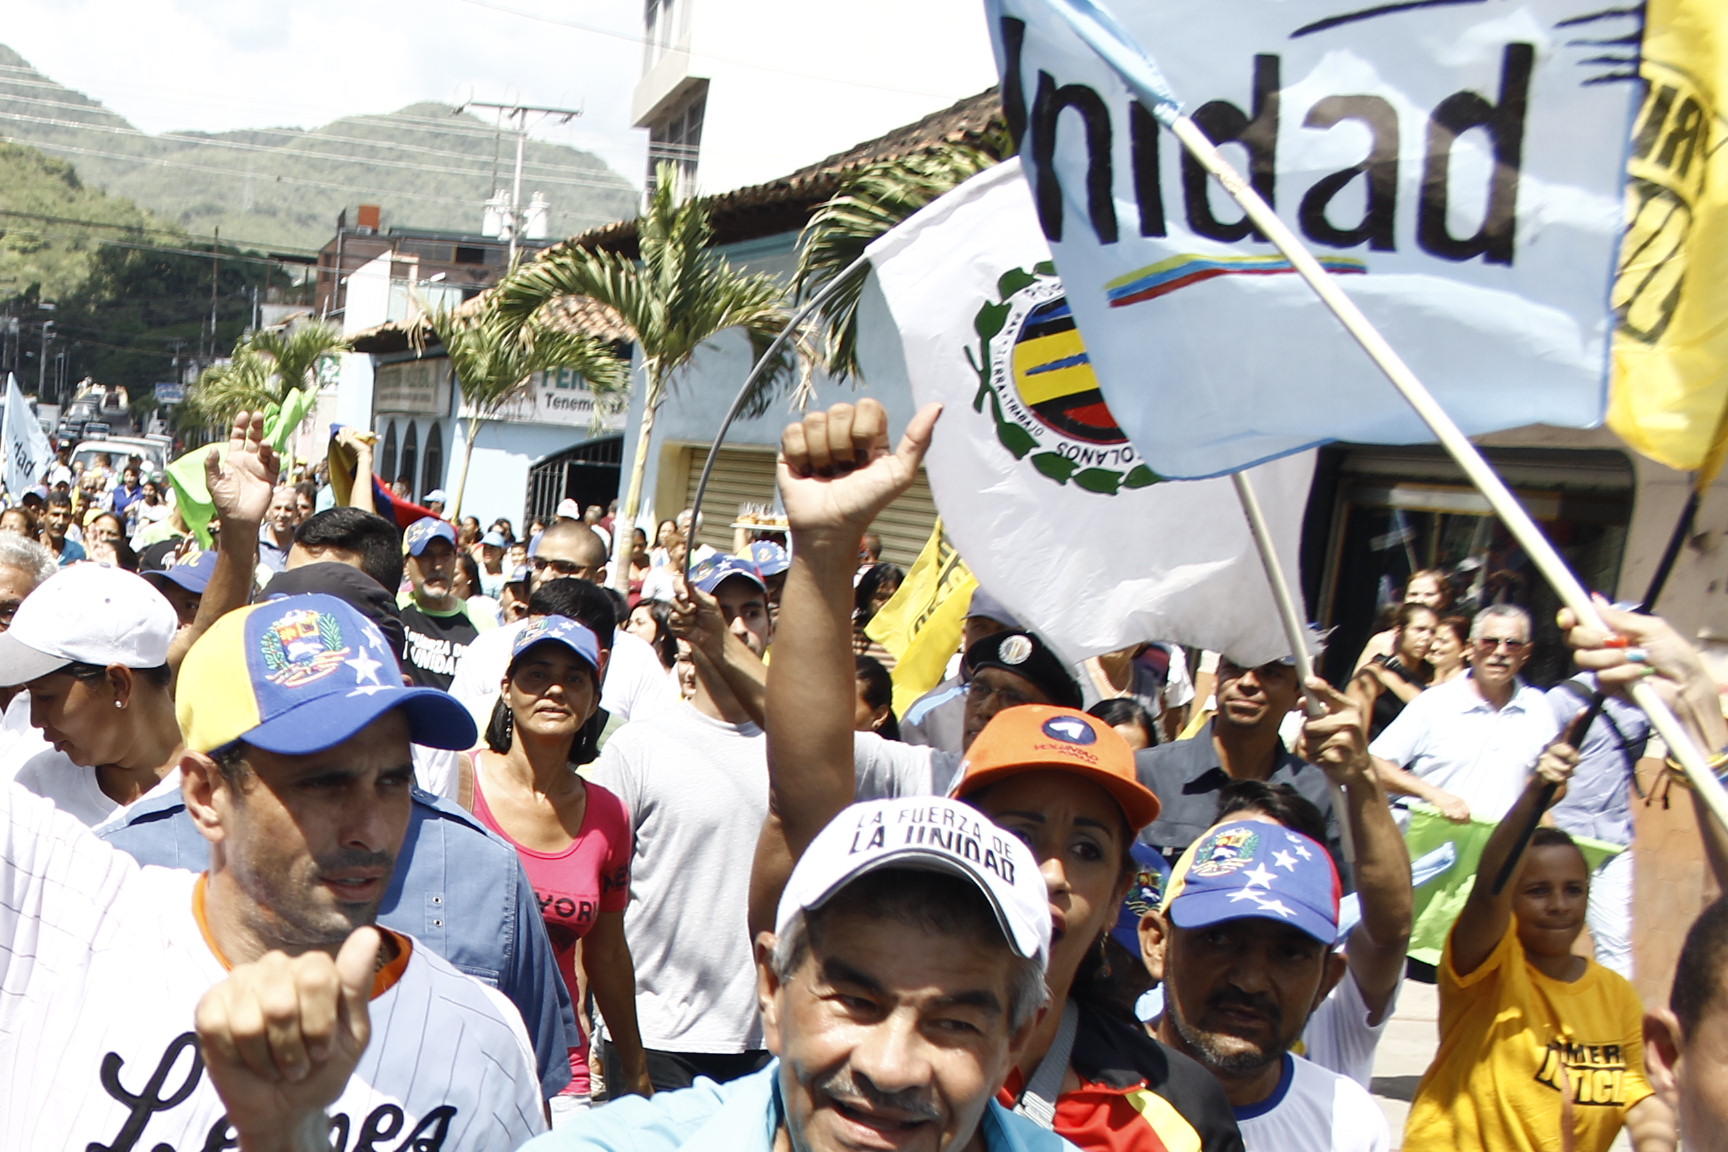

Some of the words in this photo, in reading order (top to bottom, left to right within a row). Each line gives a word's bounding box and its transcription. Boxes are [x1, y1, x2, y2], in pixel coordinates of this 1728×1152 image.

[1056, 441, 1141, 467] OLANOS
[848, 825, 886, 856] LA
[904, 825, 1015, 886] UNIDAD
[857, 810, 883, 829] LA
[897, 806, 982, 843] FUERZA
[992, 835, 1015, 862] DE
